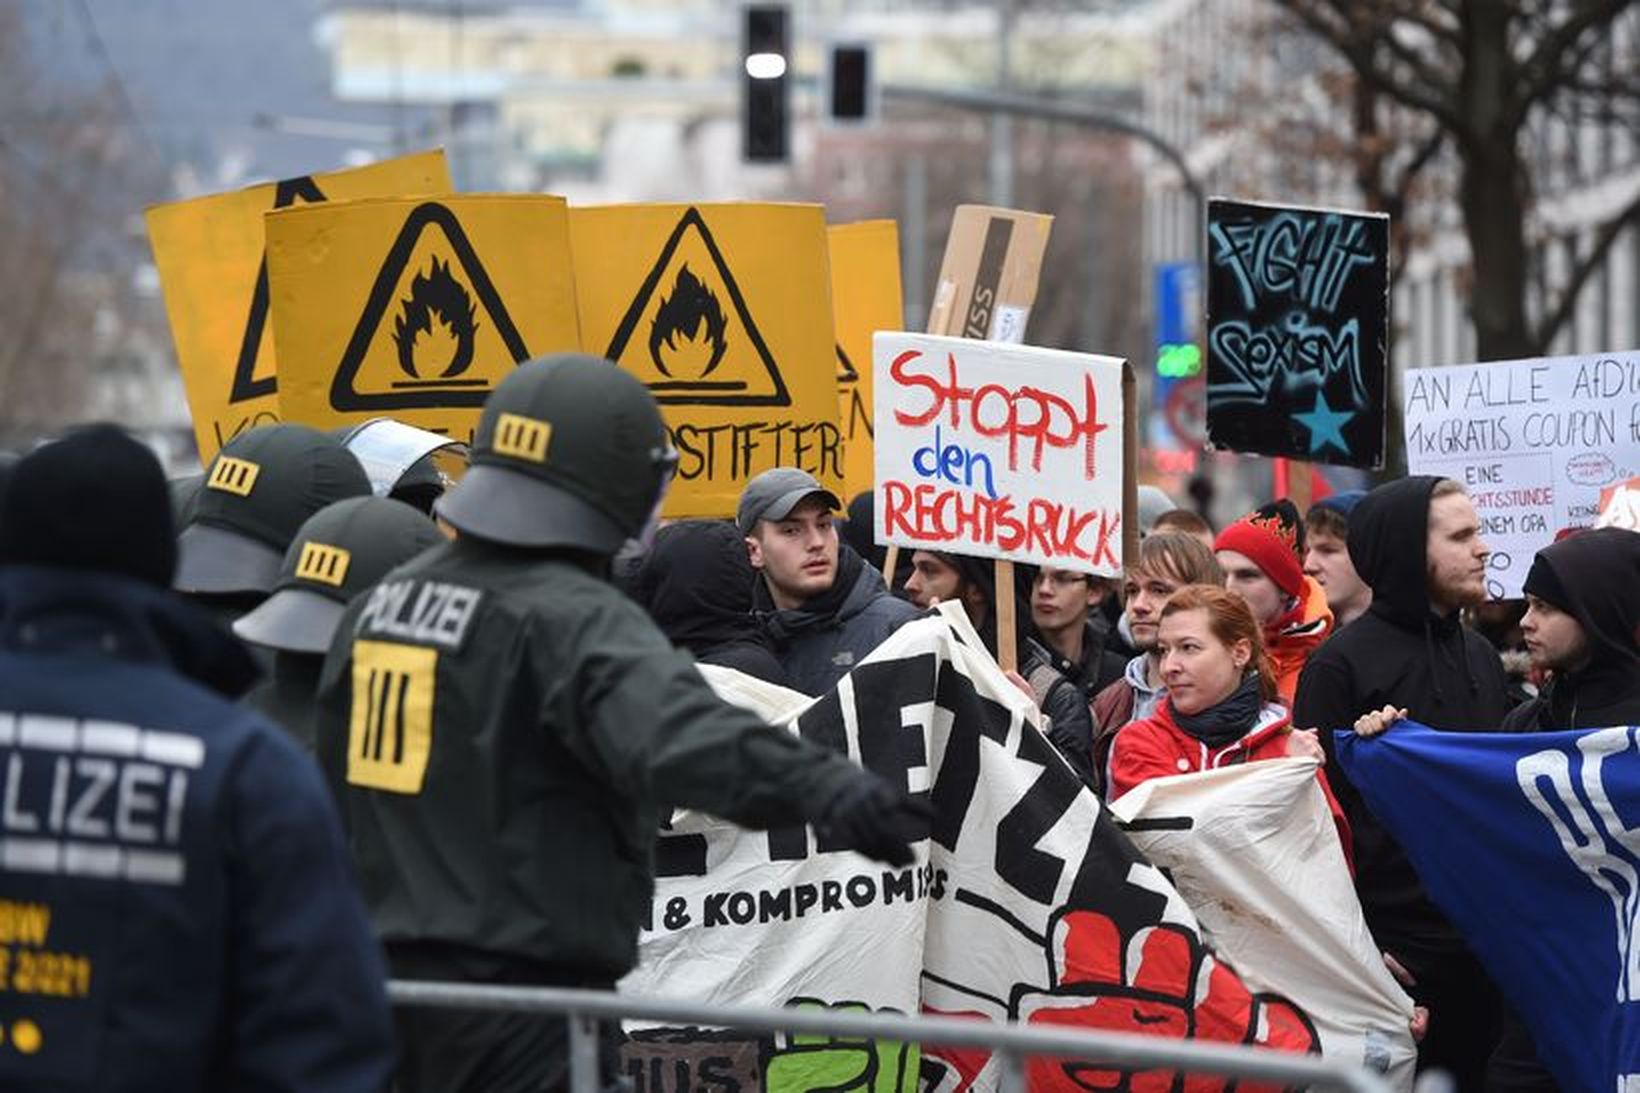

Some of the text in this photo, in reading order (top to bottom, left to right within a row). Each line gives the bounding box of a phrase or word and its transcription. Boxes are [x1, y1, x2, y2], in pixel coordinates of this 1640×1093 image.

[890, 350, 1108, 480] Stoppt
[1407, 375, 1450, 415] AN
[1464, 367, 1551, 407] ALLE
[664, 420, 844, 481] STIFTER
[1523, 409, 1615, 448] COUPON
[912, 424, 997, 499] den
[1465, 464, 1503, 485] EINE
[663, 897, 691, 930] &
